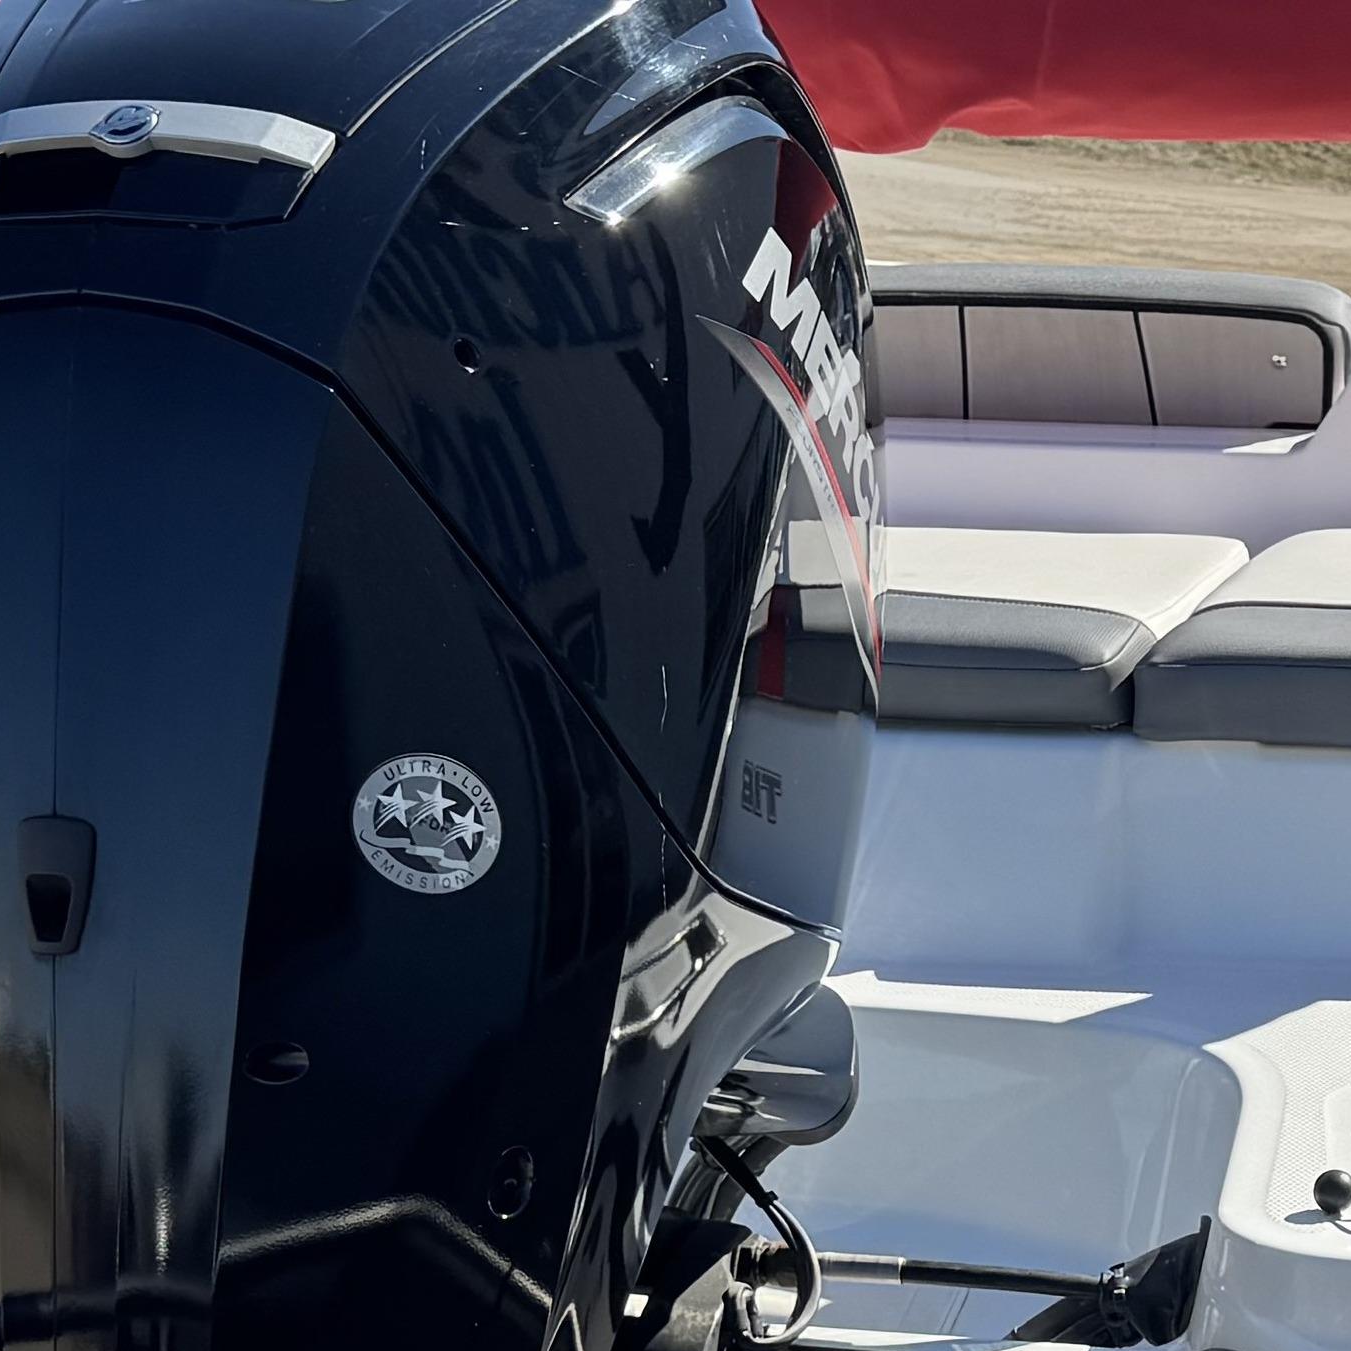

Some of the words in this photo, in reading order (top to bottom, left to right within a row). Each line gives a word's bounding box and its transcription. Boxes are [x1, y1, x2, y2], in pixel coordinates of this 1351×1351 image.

[383, 759, 447, 782] ULTRA
[461, 776, 495, 814] LOW
[370, 849, 466, 890] EMISSION
